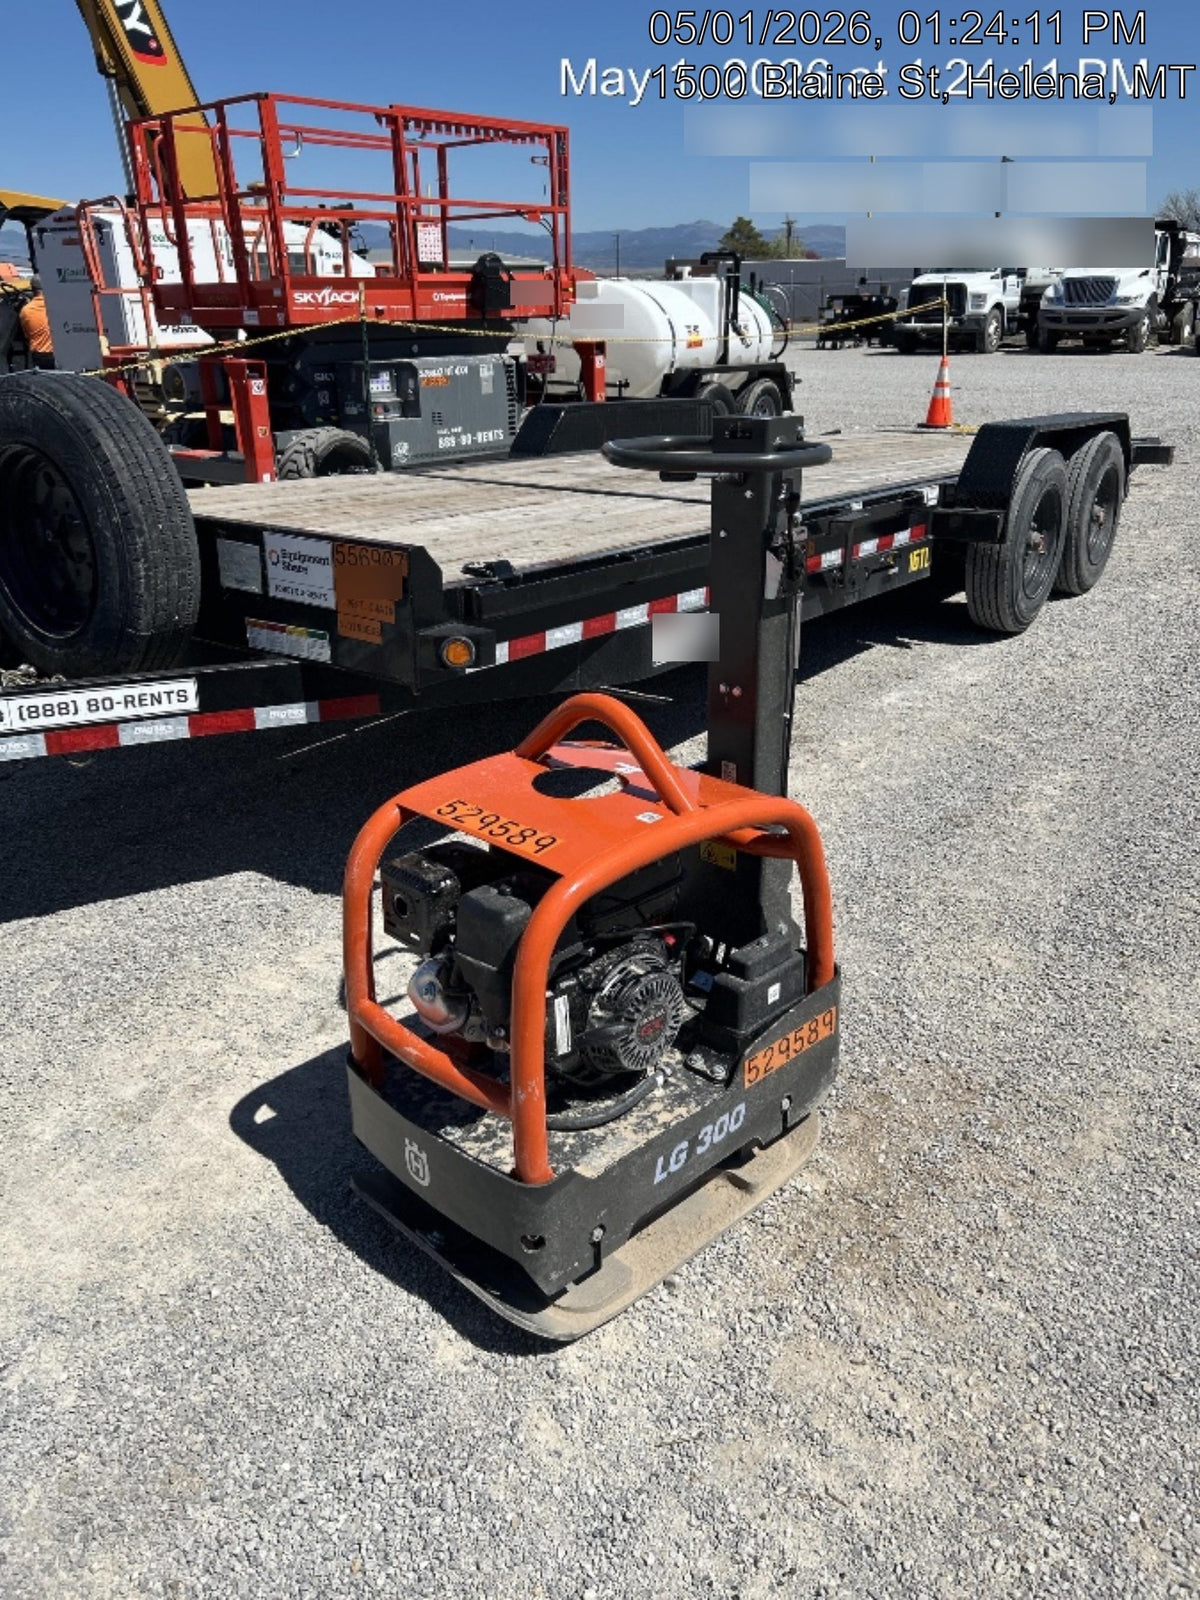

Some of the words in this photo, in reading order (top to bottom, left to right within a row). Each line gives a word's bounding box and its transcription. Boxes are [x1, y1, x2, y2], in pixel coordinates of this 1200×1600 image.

[292, 286, 361, 306] SKYJACK
[86, 689, 189, 714] 80-RENTS
[436, 799, 557, 855] 529589
[746, 1009, 834, 1084] 529589
[653, 1140, 689, 1185] LG
[696, 1102, 746, 1155] 300
